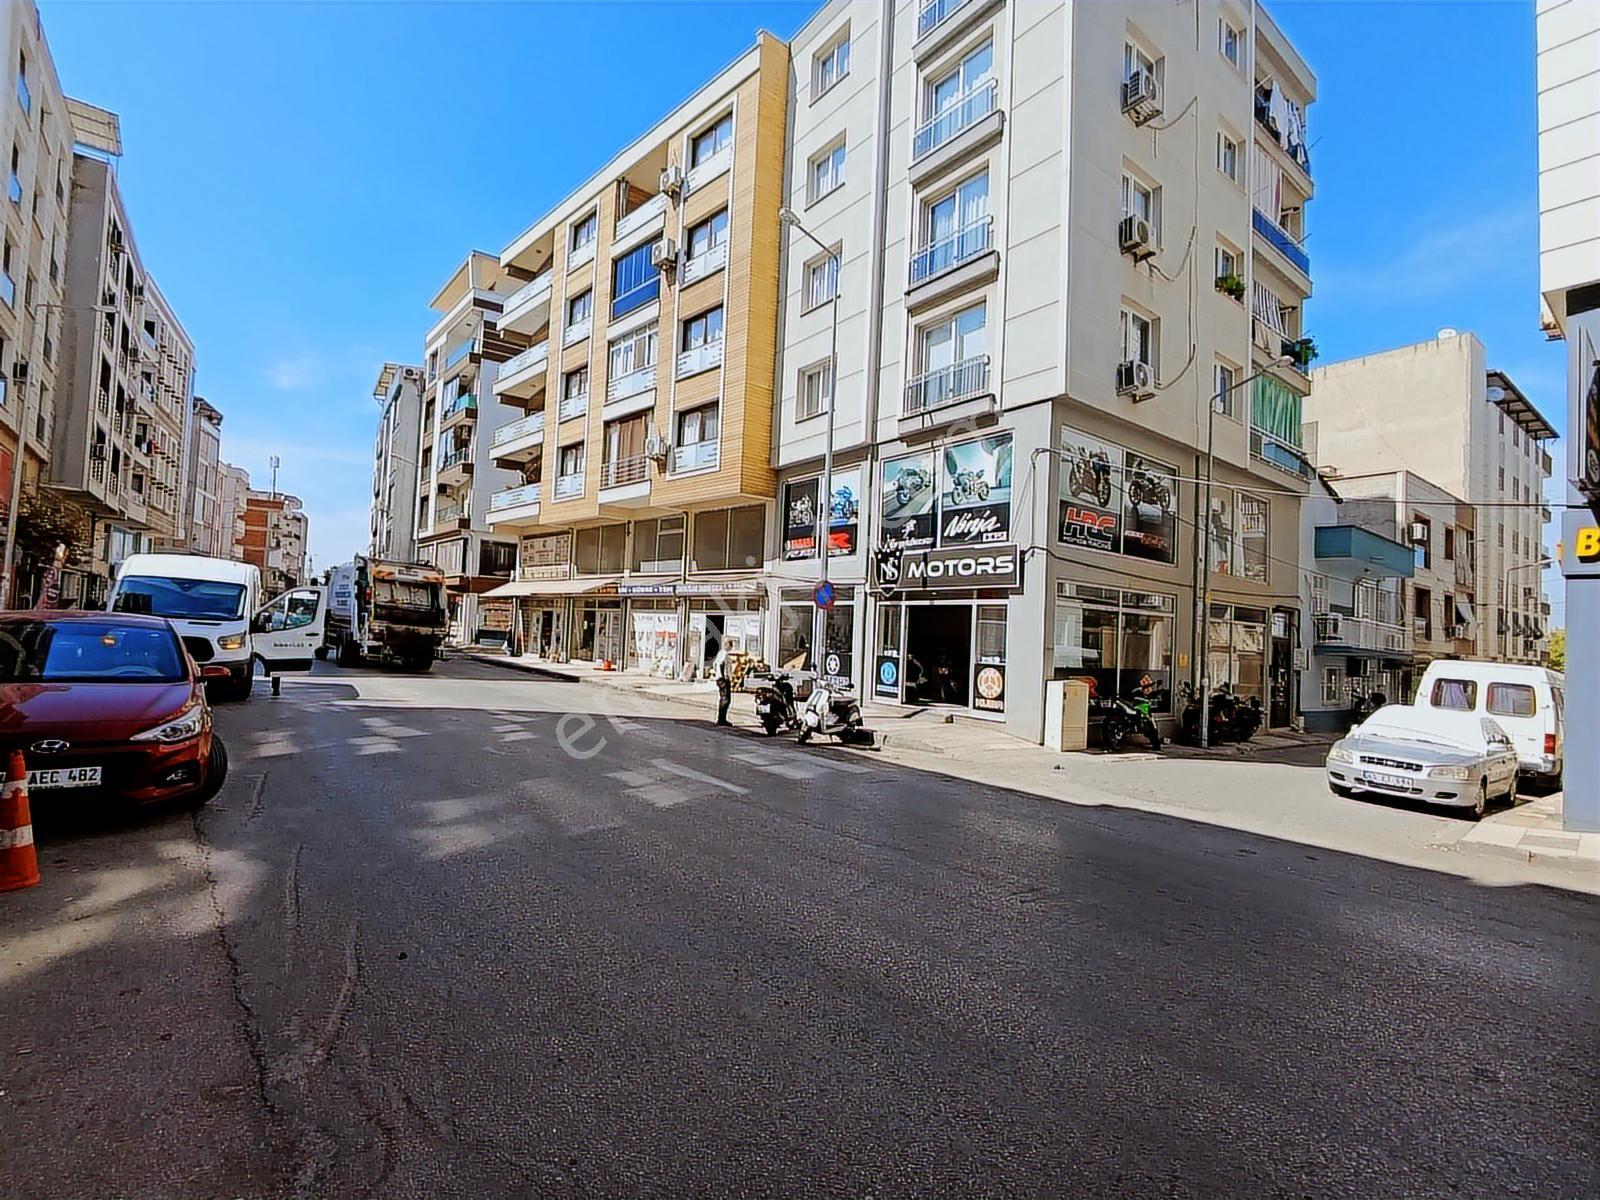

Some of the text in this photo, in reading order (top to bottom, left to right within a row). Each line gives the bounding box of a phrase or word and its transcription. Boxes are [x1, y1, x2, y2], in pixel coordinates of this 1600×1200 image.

[943, 510, 1001, 541] Ninja
[1063, 507, 1117, 543] HRC
[907, 555, 1014, 579] MOTORS
[28, 768, 98, 785] AEC 482
